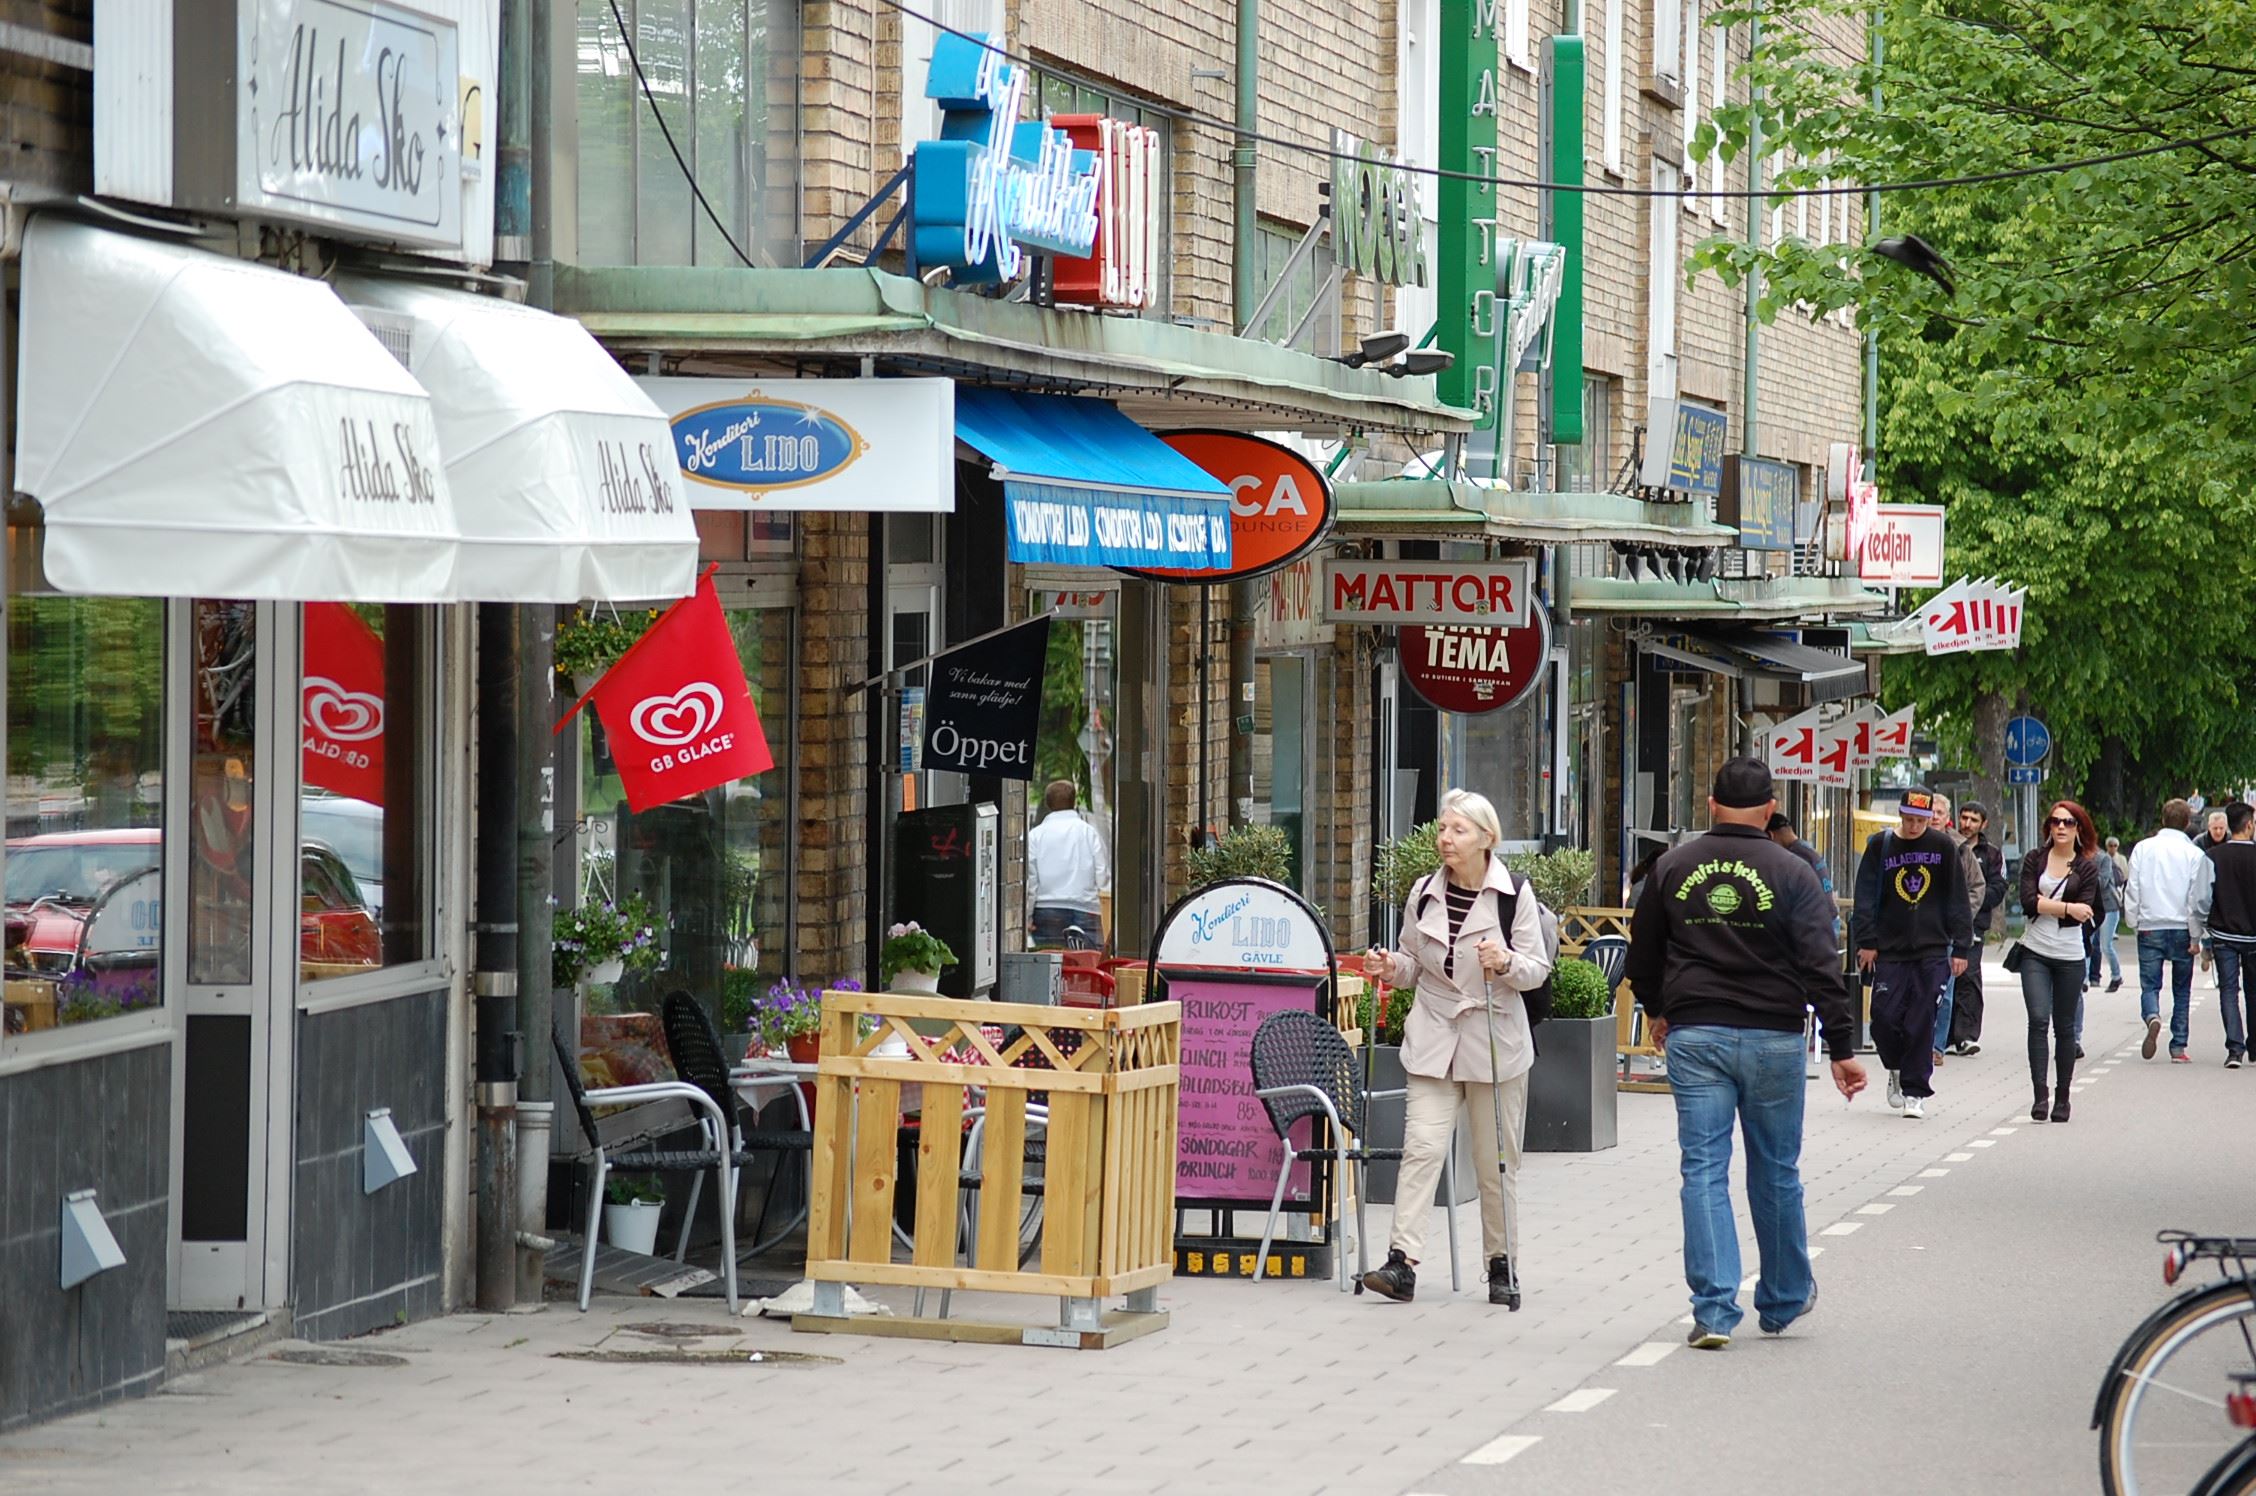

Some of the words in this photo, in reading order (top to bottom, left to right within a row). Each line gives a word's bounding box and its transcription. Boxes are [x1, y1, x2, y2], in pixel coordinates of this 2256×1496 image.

[372, 46, 425, 196] Sko
[685, 410, 761, 472] Konditori
[740, 435, 819, 472] LIDO
[392, 422, 435, 504] Sko
[639, 443, 674, 514] Sko
[1229, 474, 1309, 517] CA
[1231, 520, 1309, 533] OUNGE
[1333, 573, 1514, 613] MATTOR
[1425, 630, 1511, 674] TEMA
[1932, 638, 1970, 652] elkedjan
[948, 667, 966, 684] Vi
[967, 672, 1002, 687] bakar
[1004, 677, 1031, 690] med
[949, 689, 978, 700] sann
[976, 690, 1023, 709] glädje!
[931, 719, 1029, 769] Öppet
[650, 755, 675, 774] GB
[1774, 765, 1814, 776] elkedjan
[1720, 861, 1733, 873] &
[1191, 892, 1250, 944] Konditori
[1232, 915, 1291, 949] LIDO
[1241, 951, 1284, 964] GÄVLE
